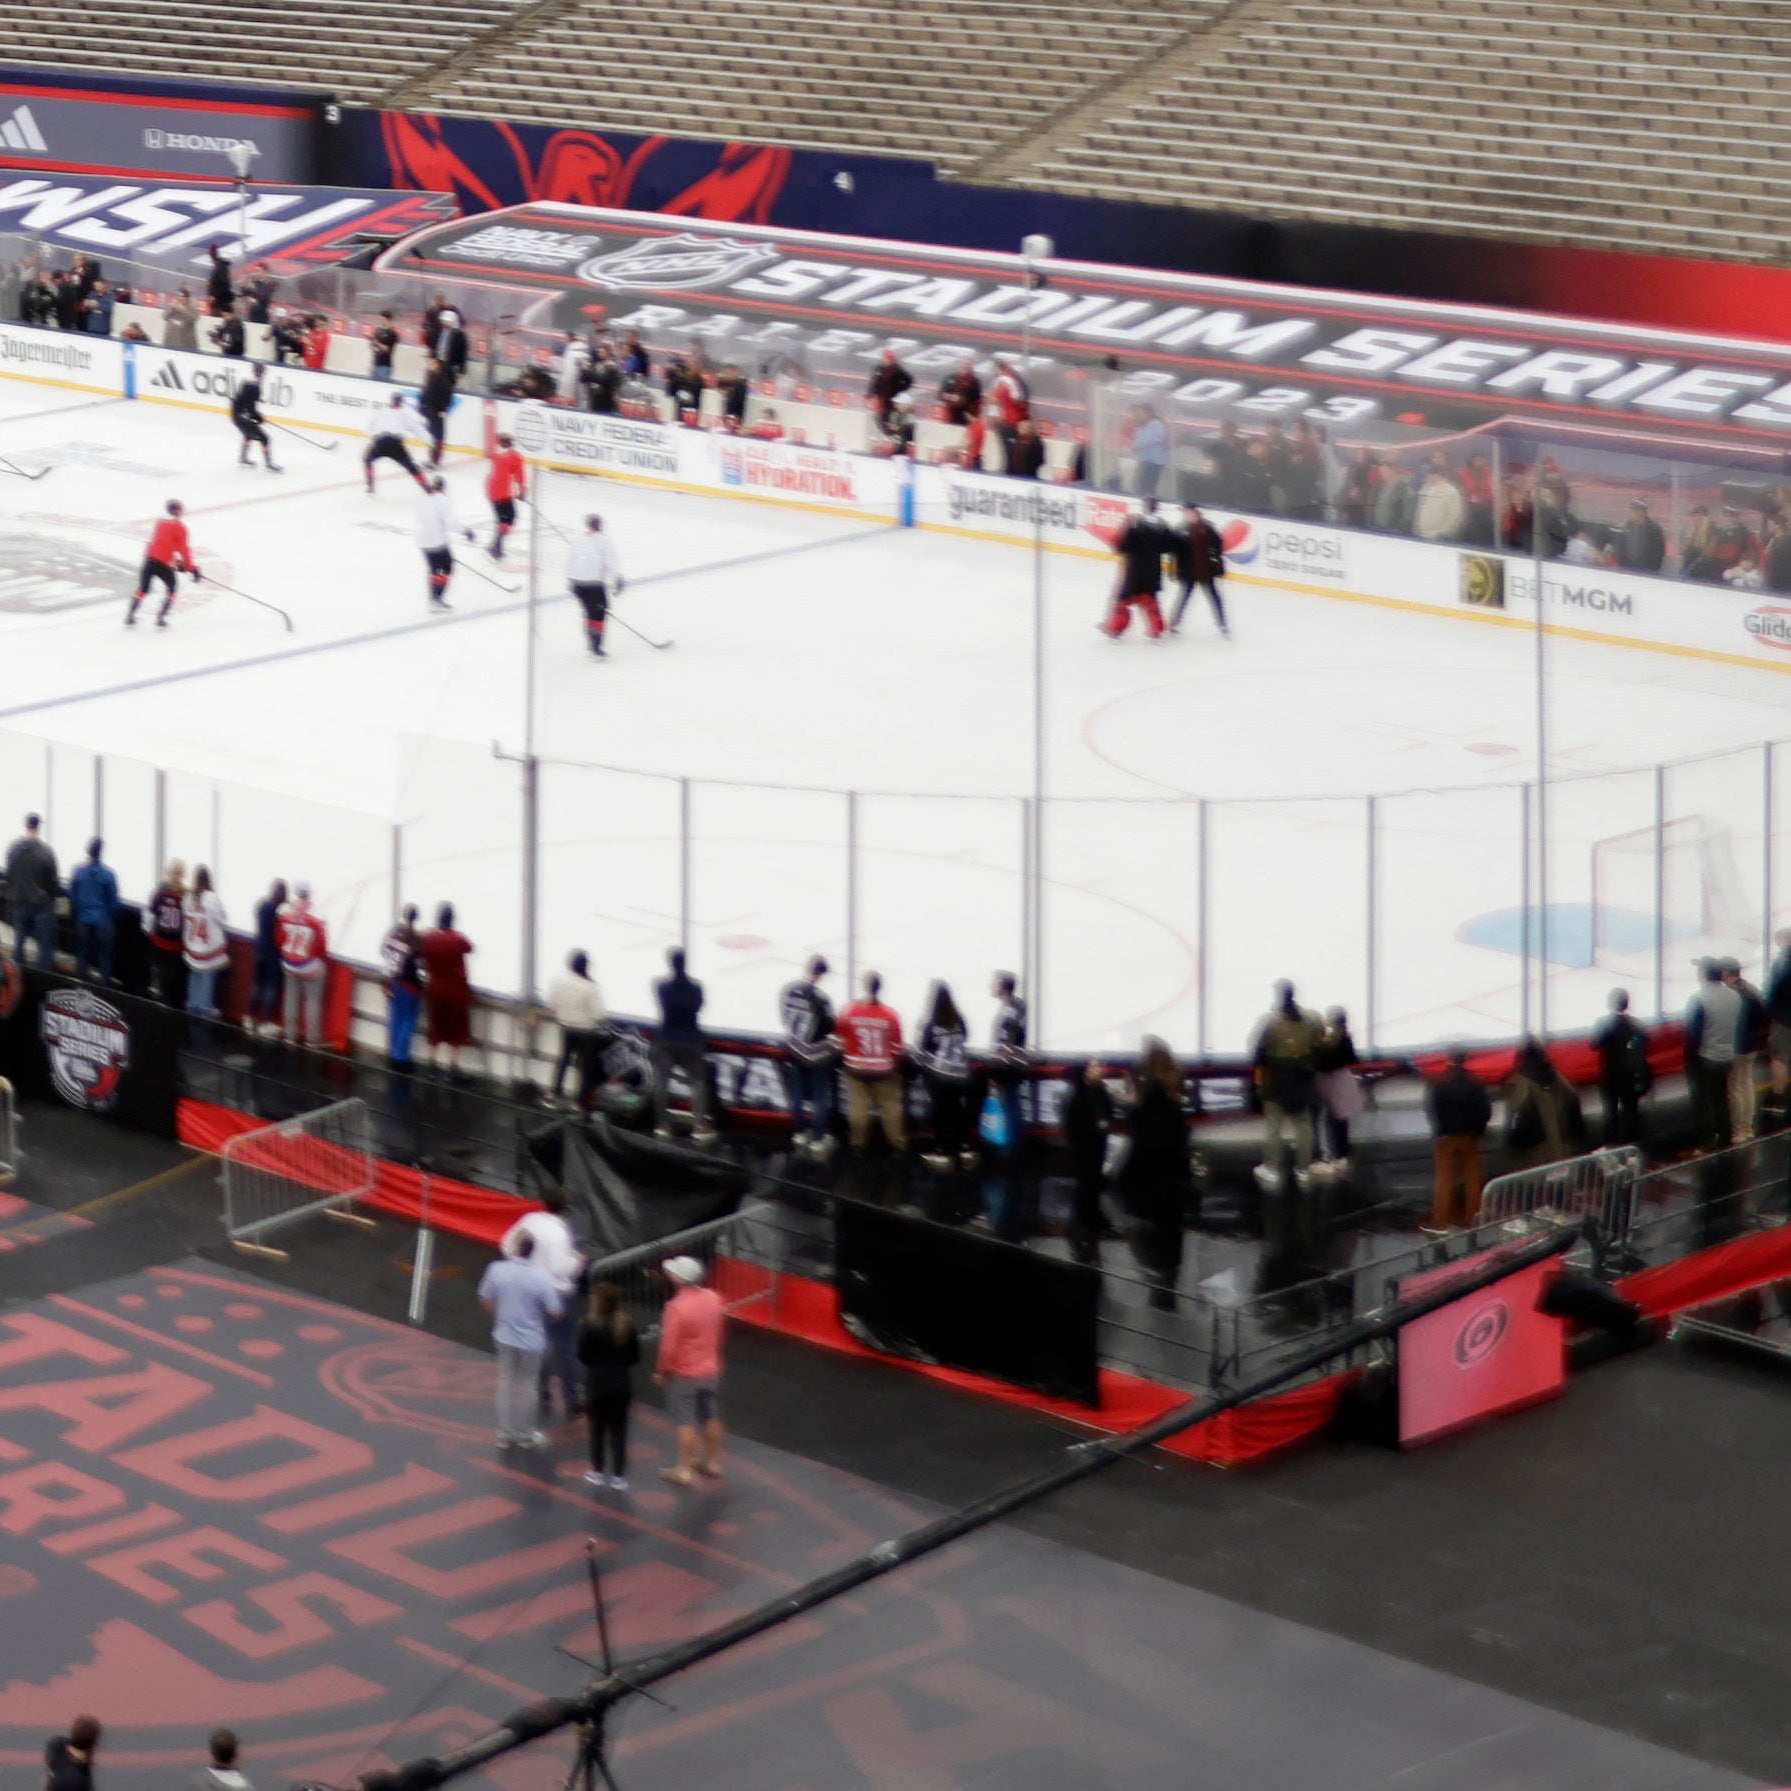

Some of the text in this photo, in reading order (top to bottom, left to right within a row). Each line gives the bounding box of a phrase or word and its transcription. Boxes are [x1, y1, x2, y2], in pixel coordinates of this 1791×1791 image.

[166, 132, 262, 156] HONDA
[730, 259, 1316, 361] STADIUM
[314, 391, 337, 404] THE
[340, 394, 368, 408] BEST
[551, 414, 597, 438] NAVY
[552, 440, 679, 472] CREDIT UNION
[948, 485, 1077, 529] guaranteed
[1265, 529, 1344, 563] pepsi
[1266, 559, 1346, 579] ZERO SUGAR
[1511, 575, 1634, 615] BETMGM
[45, 1011, 128, 1056] STADIUM
[60, 1039, 109, 1065] SERIES
